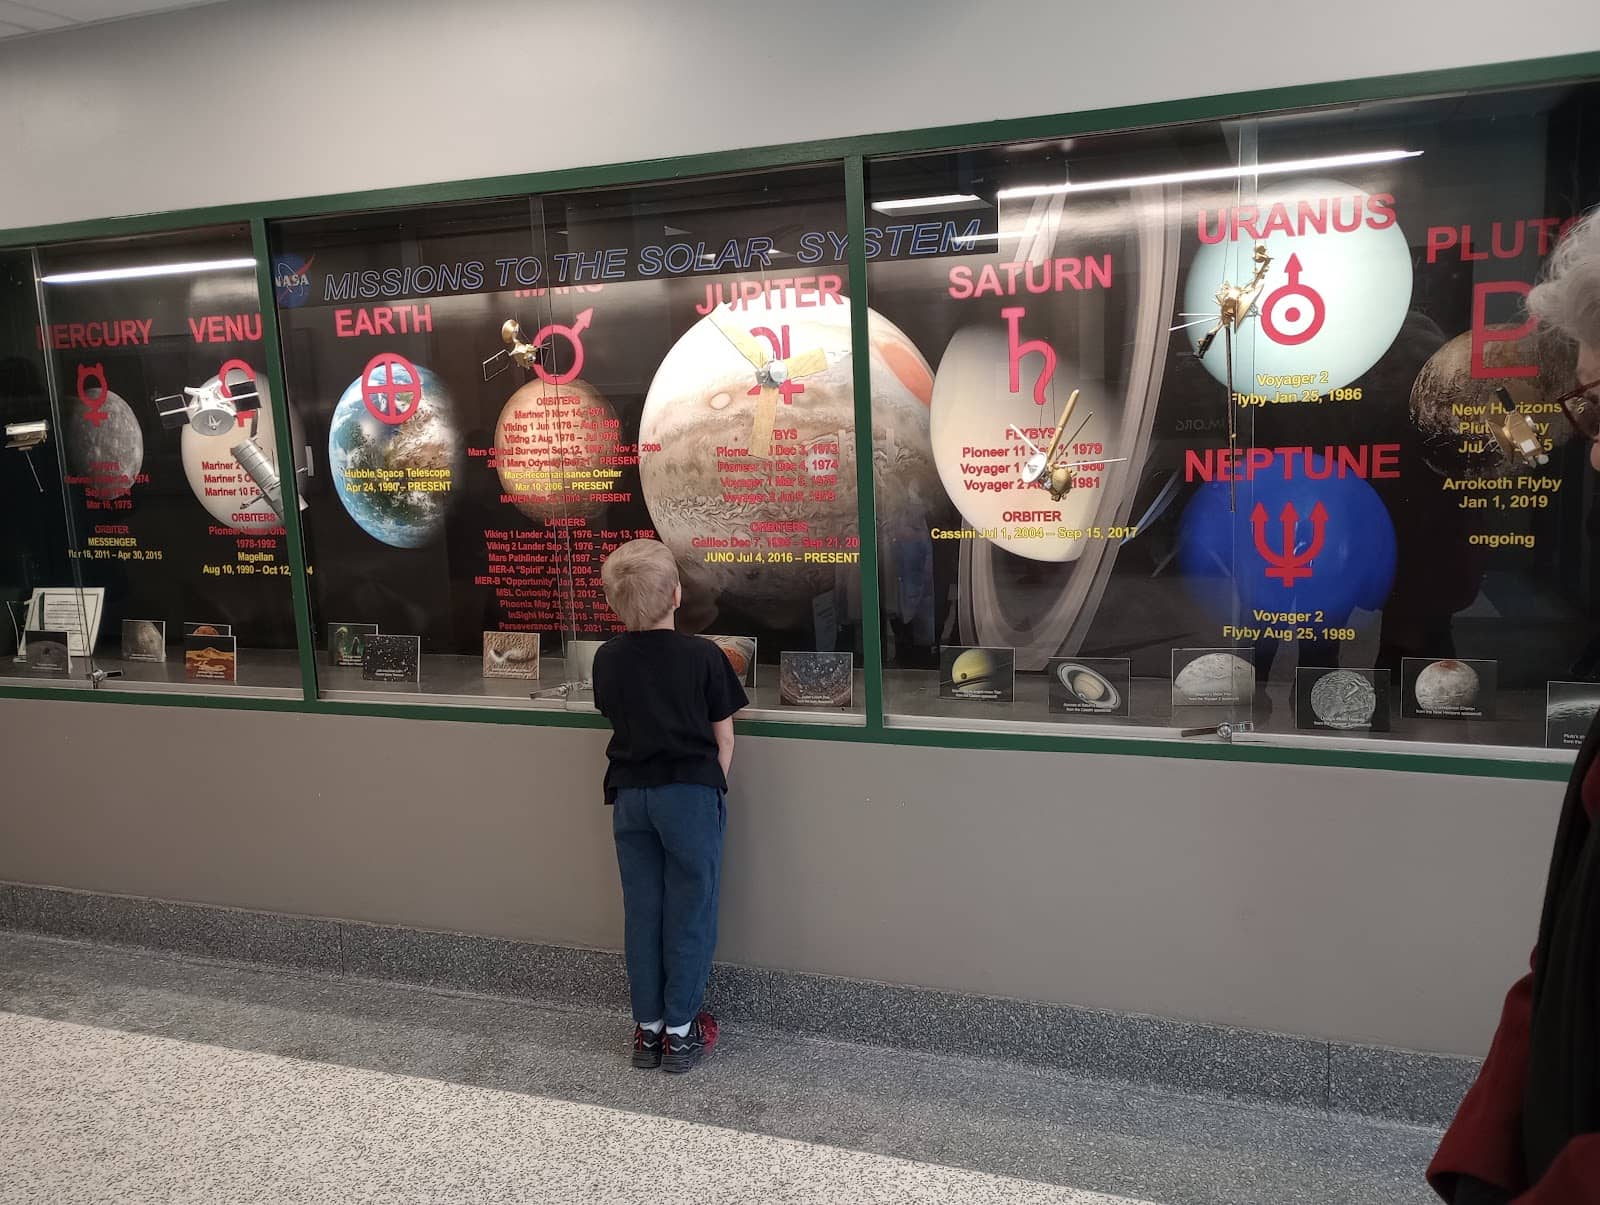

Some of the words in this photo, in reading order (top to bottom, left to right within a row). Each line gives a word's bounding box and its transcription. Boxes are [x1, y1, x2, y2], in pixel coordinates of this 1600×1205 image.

[1197, 193, 1397, 245] URANUS
[324, 261, 485, 301] MISSIONS
[495, 256, 542, 287] TO
[554, 249, 628, 281] THE
[638, 236, 774, 276] SOLAR
[948, 254, 1112, 299] SATURN
[695, 274, 844, 316] JUPITER
[334, 304, 433, 338] EARTH
[35, 319, 153, 350] MERCURY
[188, 313, 263, 344] VENU
[1256, 373, 1316, 388] Voyager
[1319, 371, 1329, 384] 2
[536, 396, 581, 406] ORBITERS
[1271, 391, 1298, 405] Jan
[1302, 390, 1323, 404] 25,
[1328, 388, 1362, 401] 1986
[514, 410, 544, 419] Mariner
[1452, 404, 1487, 416] New
[503, 423, 527, 433] Viking
[467, 447, 487, 457] Mars
[613, 443, 631, 453] Nov
[962, 446, 1010, 458] Pioneer
[1013, 445, 1026, 457] 11
[1072, 443, 1103, 455] 1979
[202, 461, 233, 471] Mariner
[600, 456, 642, 465] PRESENT
[812, 459, 839, 471] 1974
[1185, 444, 1400, 482] NEPTUNE
[344, 468, 375, 478] Hubble
[376, 468, 404, 480] Space
[406, 467, 451, 479] Telescope
[593, 469, 622, 479] Orbiter
[960, 463, 1011, 476] Voyager
[1014, 462, 1020, 473] 1
[204, 474, 236, 484] Mariner
[237, 473, 243, 483] 5
[1442, 477, 1513, 490] Arrokoth
[1517, 476, 1561, 492] Flyby
[345, 482, 361, 493] Apr
[364, 482, 376, 493] 24,
[379, 481, 398, 492] 1990
[408, 481, 452, 492] PRESENT
[515, 482, 529, 492] Mar
[572, 481, 614, 491] PRESENT
[964, 479, 1015, 493] Voyager
[1017, 478, 1025, 490] 2
[205, 487, 236, 497] Mariner
[239, 487, 248, 497] 10
[590, 493, 632, 503] PRESENT
[1458, 496, 1487, 509] Jan
[1492, 495, 1506, 510] 1,
[1510, 495, 1548, 508] 2019
[231, 512, 277, 523] ORBITERS
[1002, 510, 1063, 523] ORBITER
[544, 518, 586, 528] LANDERS
[484, 529, 508, 540] Viking
[516, 529, 543, 539] Lander
[601, 530, 618, 539] Nov
[621, 530, 632, 540] 13,
[931, 527, 976, 539] Cassini
[979, 527, 998, 540] Jul
[1001, 527, 1012, 541] 1,
[1014, 527, 1045, 539] 2004
[1058, 527, 1083, 541] Sep
[1085, 527, 1105, 540] 15,
[1108, 526, 1138, 538] 2017
[1469, 531, 1535, 548] ongoing
[88, 537, 138, 547] MESSENGER
[486, 542, 511, 552] Viking
[512, 541, 517, 551] 2
[518, 542, 545, 551] Lander
[602, 542, 617, 553] Apr
[692, 537, 729, 548] Galileo
[95, 549, 110, 559] 2011
[118, 550, 131, 561] Apr
[146, 551, 163, 560] 2015
[238, 552, 274, 563] Magellan
[488, 553, 507, 562] Mars
[508, 553, 548, 563] Pathfinder
[572, 554, 591, 563] 1997
[704, 553, 735, 563] JUNO
[737, 552, 753, 563] Jul
[755, 552, 765, 565] 4,
[768, 552, 793, 563] 2016
[804, 552, 860, 563] PRESENT
[203, 565, 221, 576] Aug
[222, 565, 235, 576] 10,
[236, 565, 254, 575] 1990
[263, 565, 278, 575] Oct
[280, 566, 292, 577] 12,
[488, 565, 515, 574] MER-A
[572, 566, 592, 575] 2004
[577, 590, 597, 599] 2012
[1253, 610, 1312, 624] Voyager
[1315, 611, 1323, 622] 2
[499, 622, 553, 631] Perseverance
[1223, 626, 1261, 641] Flyby
[1263, 627, 1293, 642] Aug
[1296, 628, 1317, 642] 25,
[1322, 628, 1356, 641] 1989
